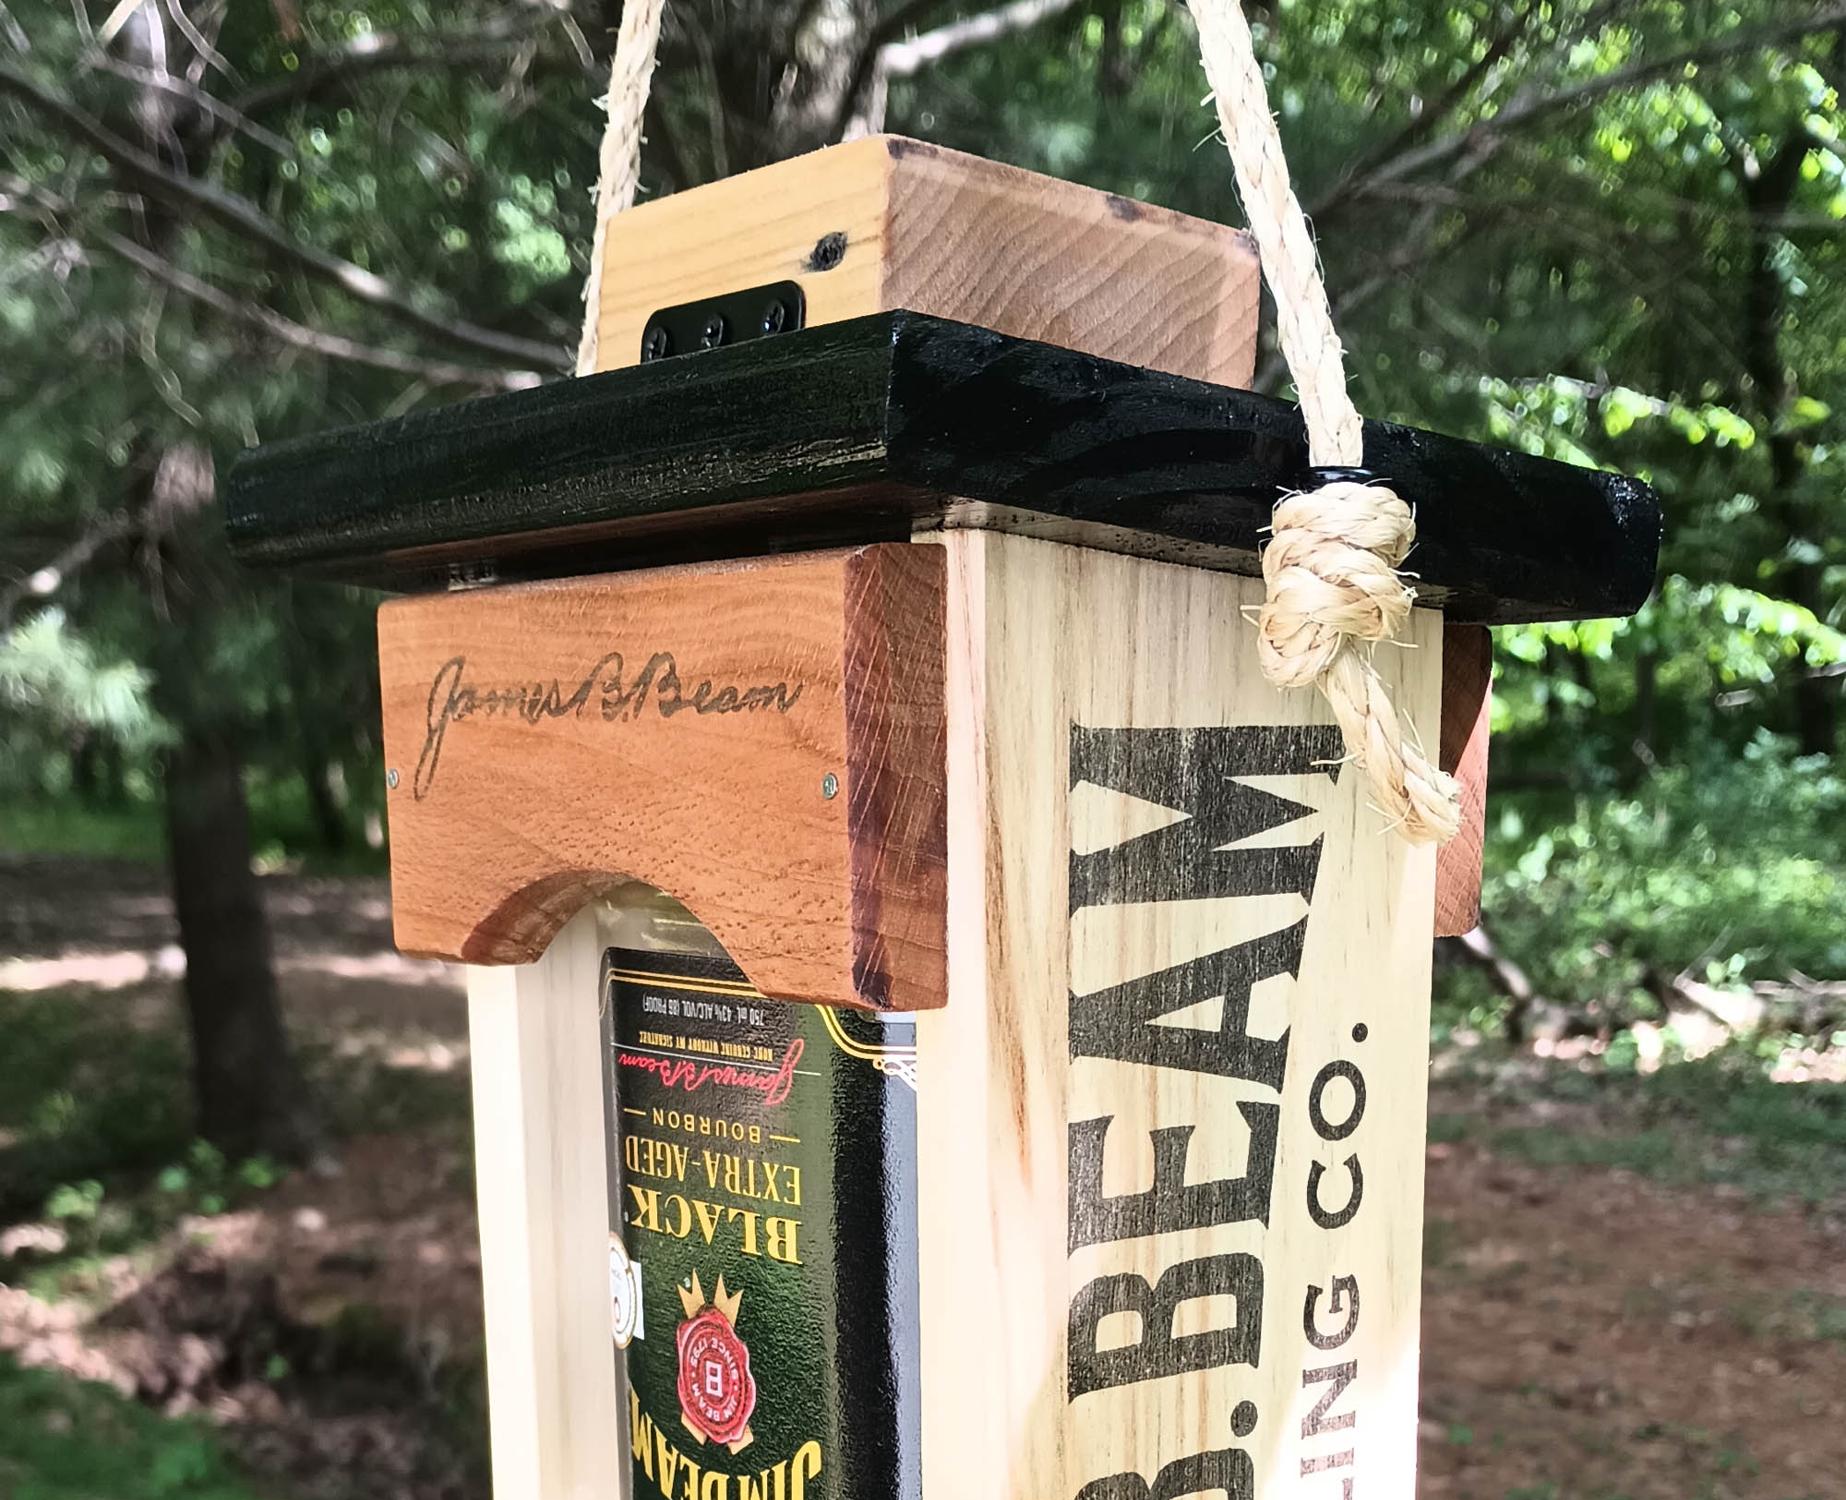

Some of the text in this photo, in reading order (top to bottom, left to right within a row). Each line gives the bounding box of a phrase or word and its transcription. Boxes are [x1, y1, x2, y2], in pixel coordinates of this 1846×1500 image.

[715, 1005, 731, 1022] 43%
[750, 1008, 764, 1025] 750
[640, 1031, 773, 1062] NONE GENUINE WITHOUT MY SIGNATURE
[1067, 725, 1347, 1404] BEAM
[653, 1109, 760, 1143] BOURBON
[1306, 1022, 1369, 1230] CO.
[626, 1135, 800, 1205] EXTRA-AGED
[627, 1184, 802, 1264] BLACK
[692, 1383, 737, 1421] JIM BEAM
